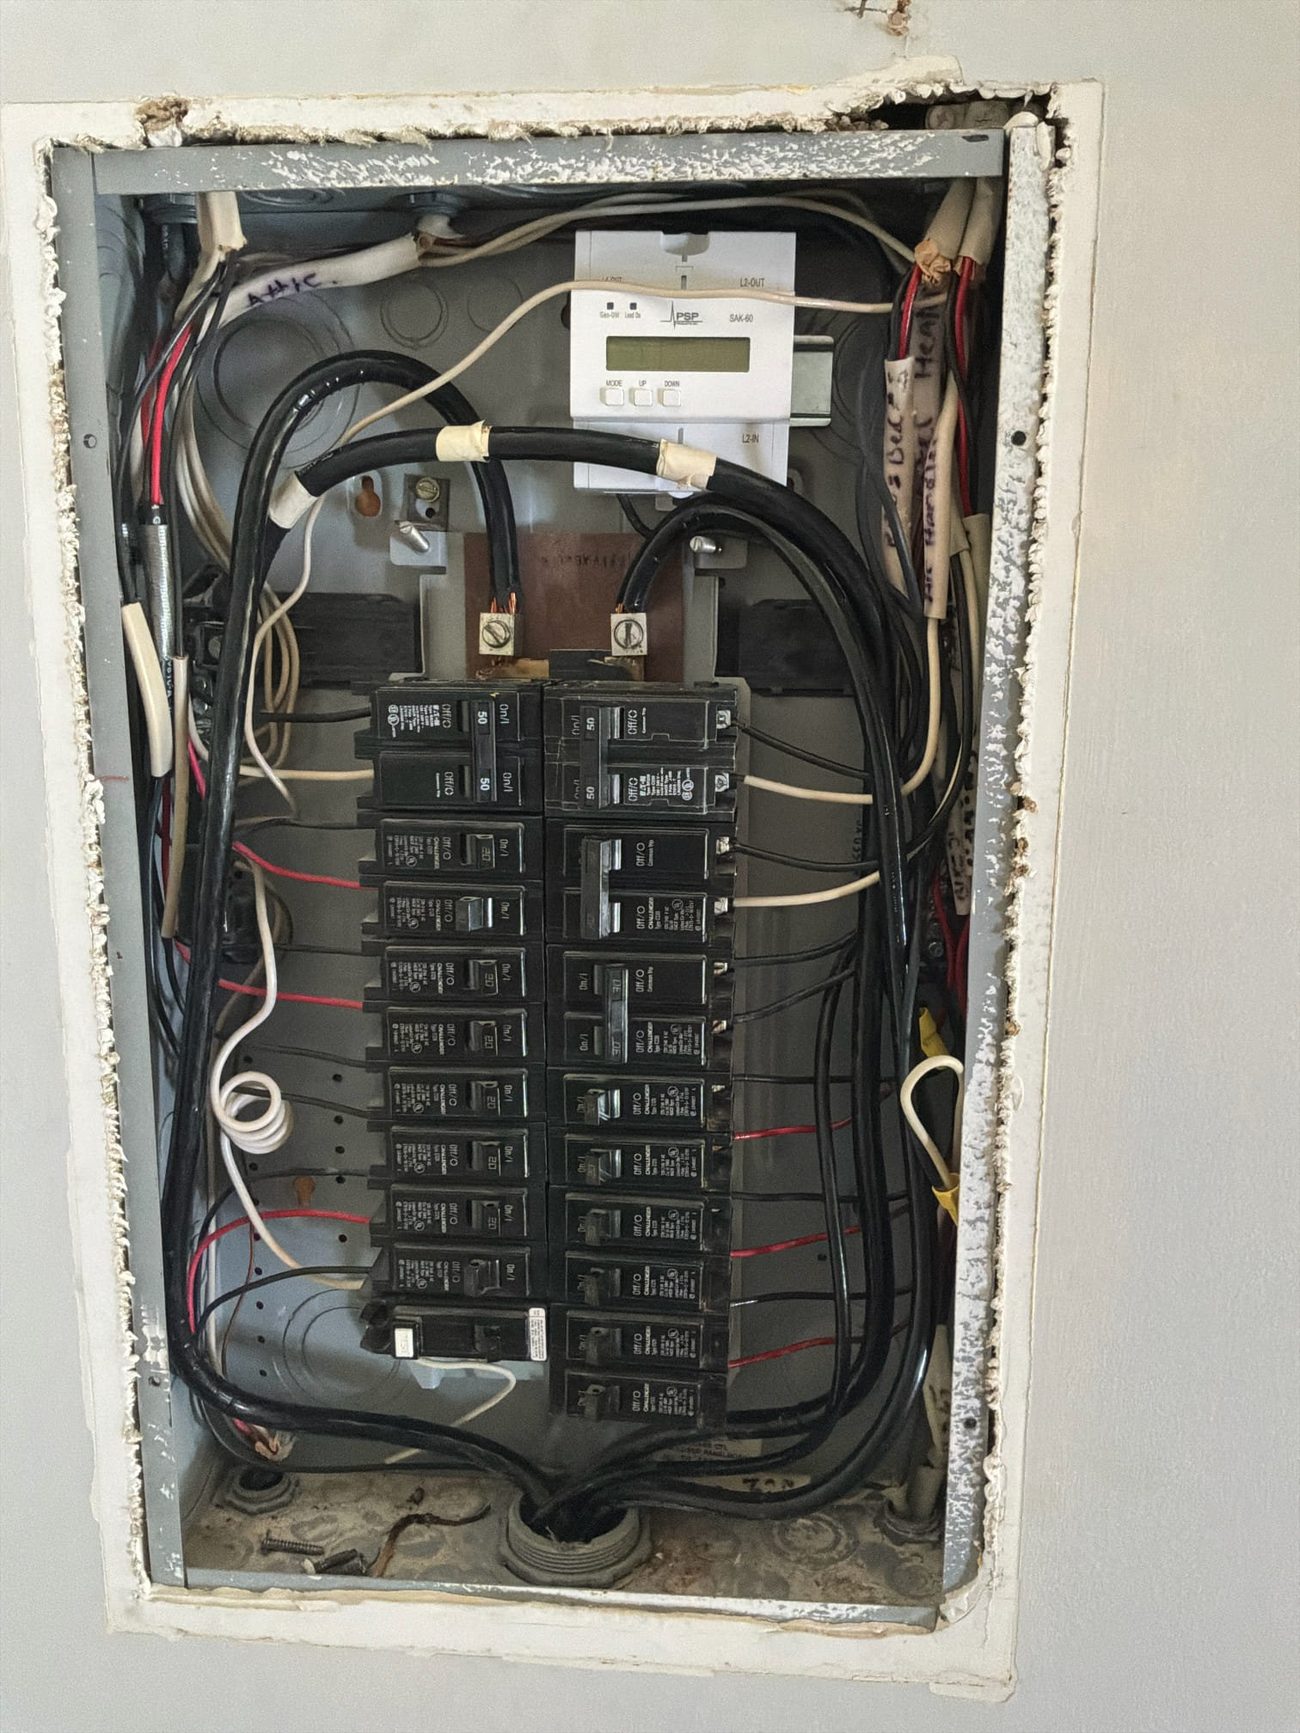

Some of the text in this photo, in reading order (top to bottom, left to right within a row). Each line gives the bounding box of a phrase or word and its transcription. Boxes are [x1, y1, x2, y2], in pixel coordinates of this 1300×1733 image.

[740, 278, 764, 287] L2-OUT
[676, 312, 699, 321] PSP
[729, 314, 753, 323] SAK-60
[742, 434, 759, 444] L2-IN
[478, 711, 488, 724] 50
[587, 717, 595, 731] 50
[480, 778, 490, 791] 50
[587, 786, 595, 800] 50
